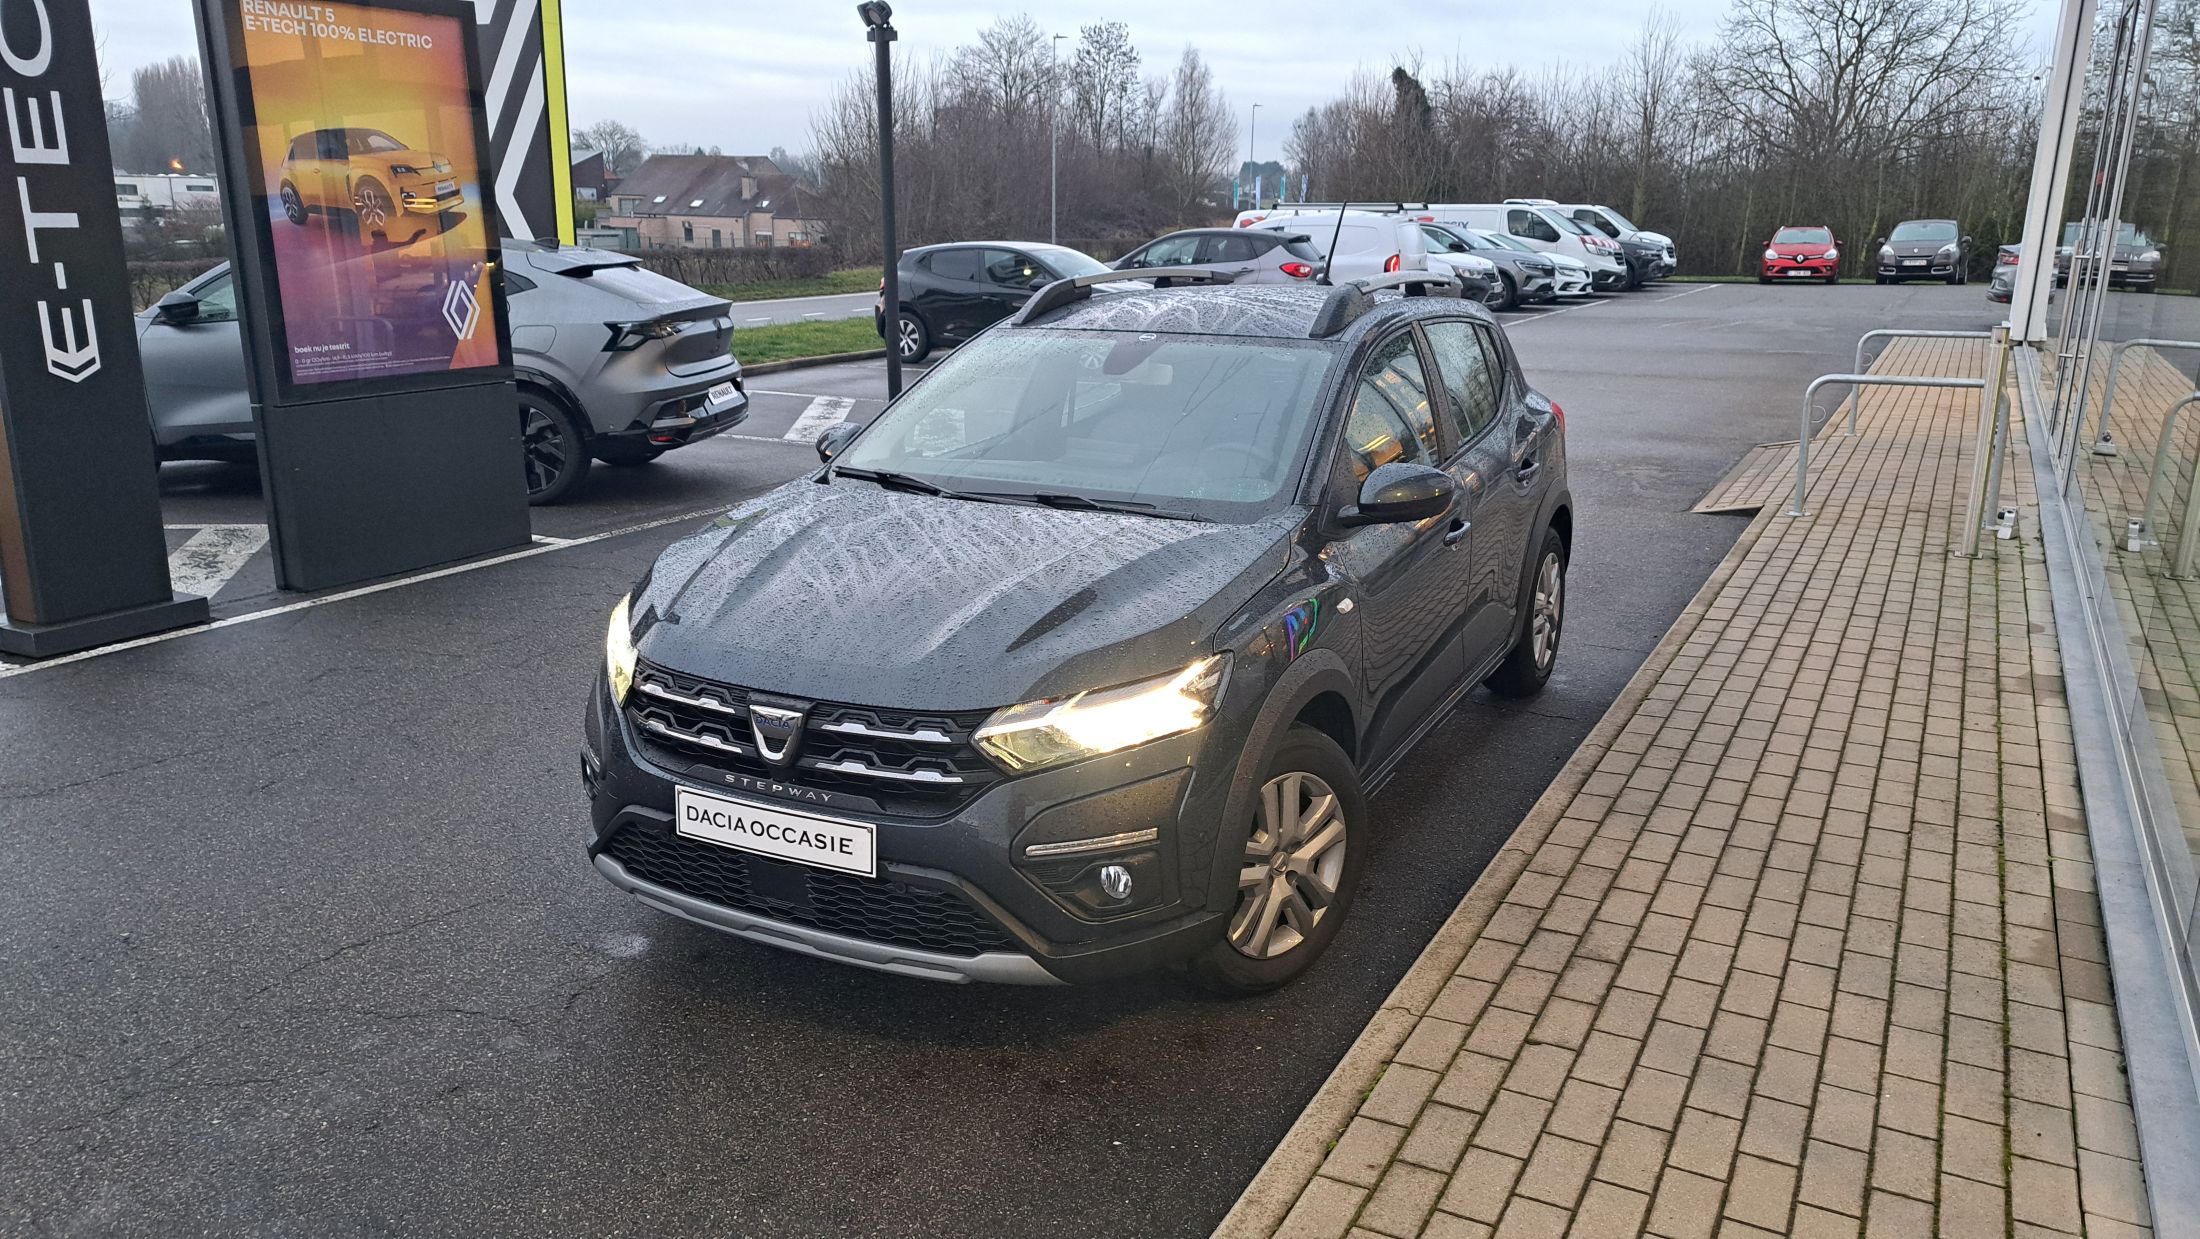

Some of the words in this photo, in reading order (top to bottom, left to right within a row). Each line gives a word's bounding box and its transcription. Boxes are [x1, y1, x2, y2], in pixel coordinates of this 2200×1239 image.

[243, 0, 321, 21] RENAULT
[325, 8, 335, 23] 5
[245, 15, 307, 37] E-TECH
[310, 22, 355, 41] 100%
[358, 28, 433, 49] ELECTRIC
[294, 345, 312, 354] boek
[756, 716, 790, 730] DACIA
[724, 774, 832, 802] STEPWAY
[686, 805, 747, 834] DACIA
[750, 820, 853, 855] OCCASIE
